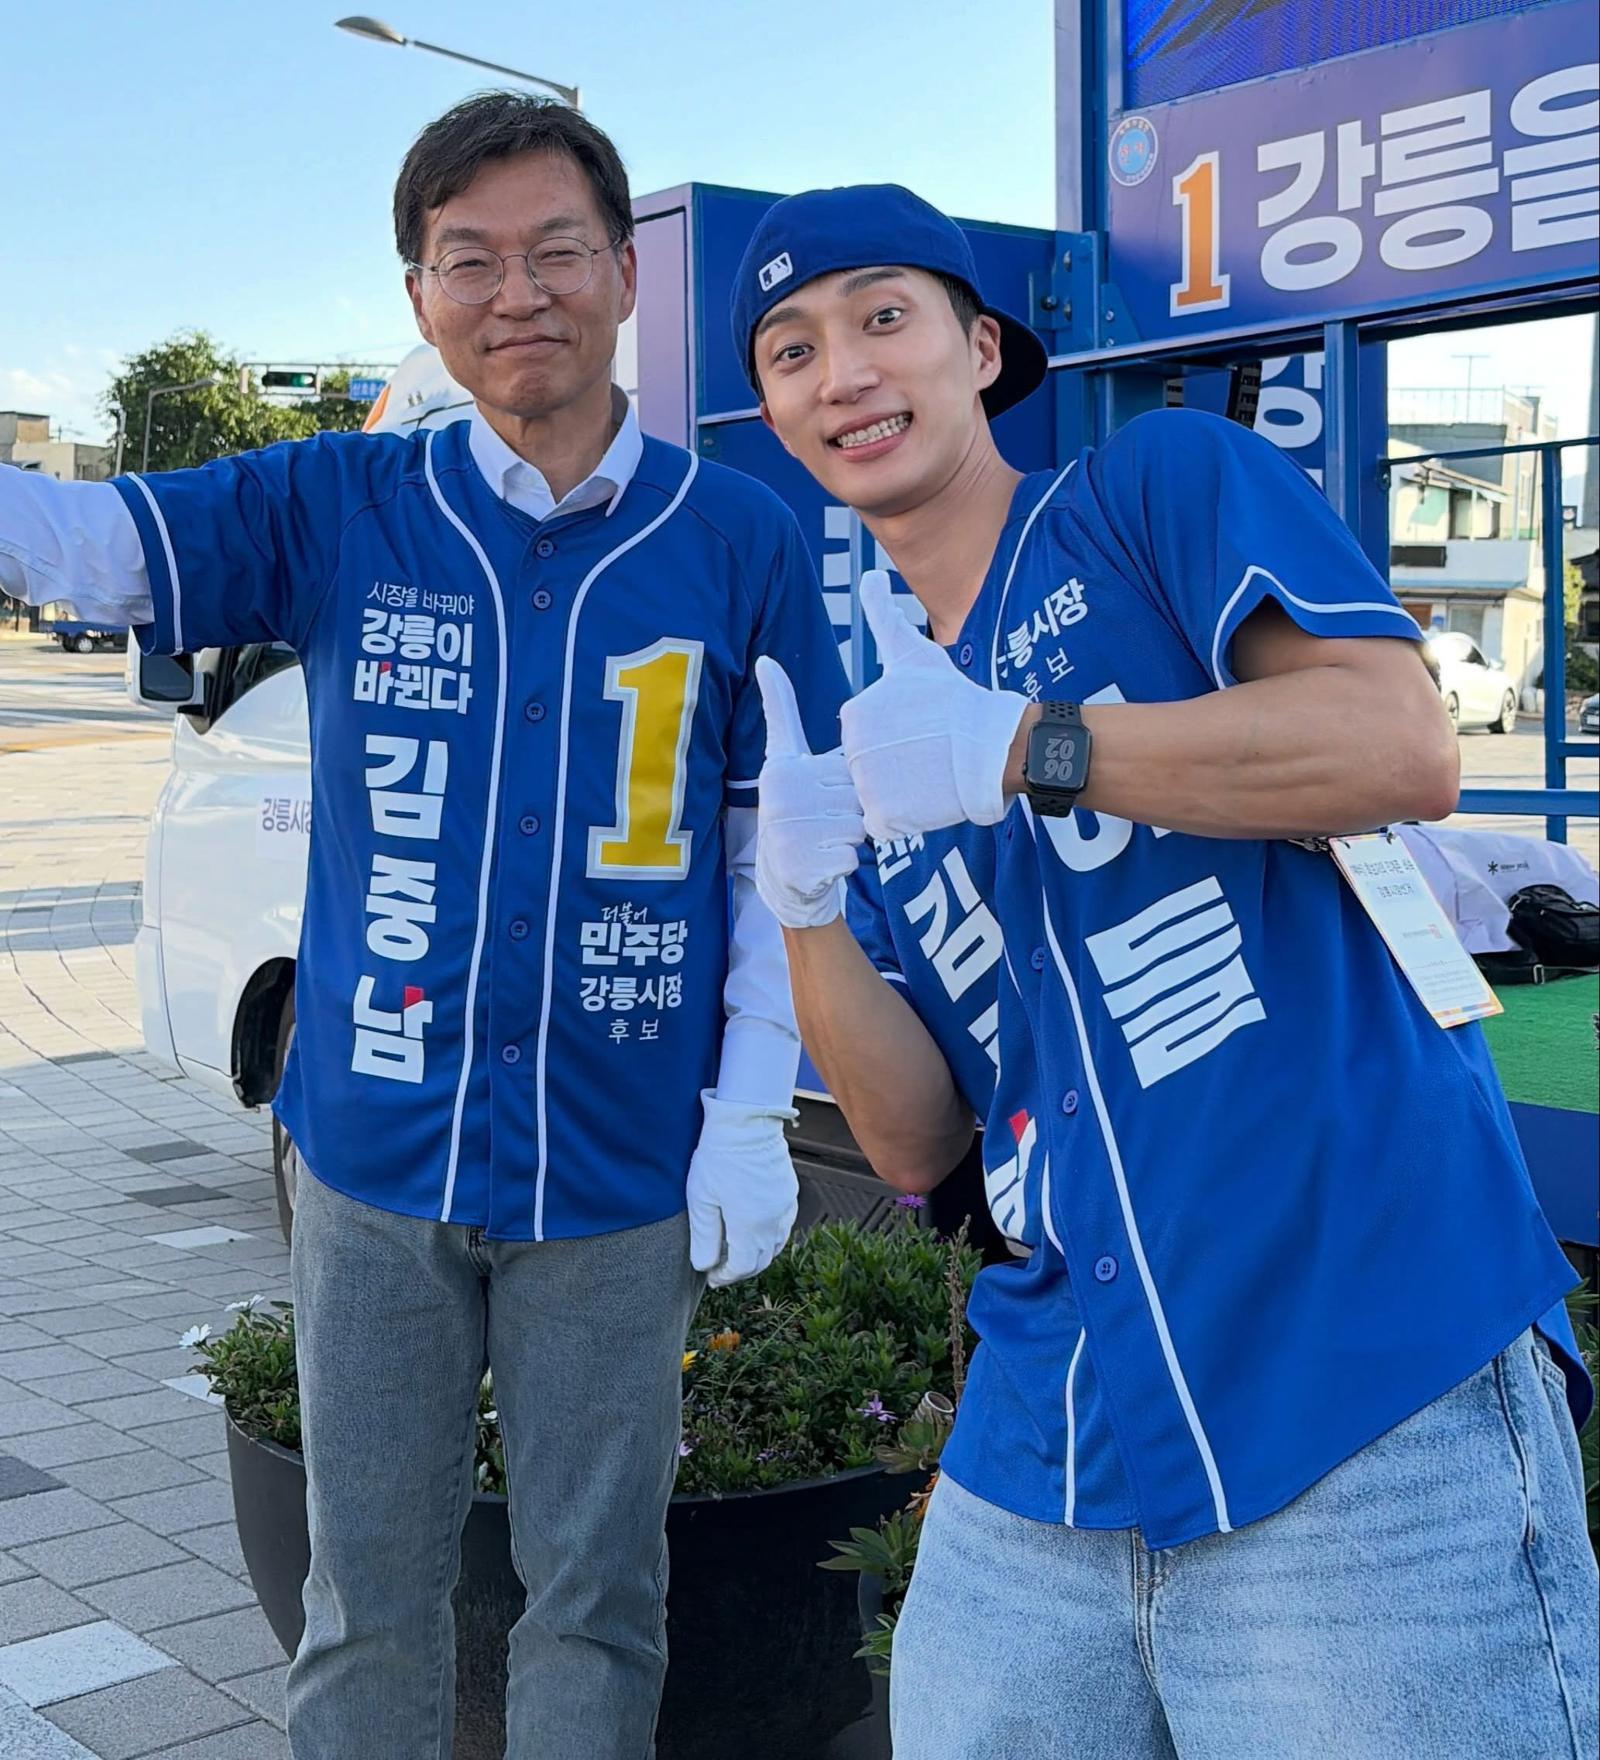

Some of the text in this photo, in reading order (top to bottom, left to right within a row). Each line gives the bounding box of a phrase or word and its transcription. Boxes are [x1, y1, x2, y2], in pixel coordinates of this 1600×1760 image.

[1170, 63, 1599, 317] 1 강릉을
[366, 581, 475, 616] 시장을 바꿔야
[361, 608, 473, 667] 강릉이
[353, 659, 474, 715] 바뀐다
[585, 636, 704, 881] 1
[350, 734, 448, 1084] 김중남
[601, 901, 648, 926] 더불어
[580, 920, 688, 966] 민주당
[579, 972, 683, 1012] 강릉시장
